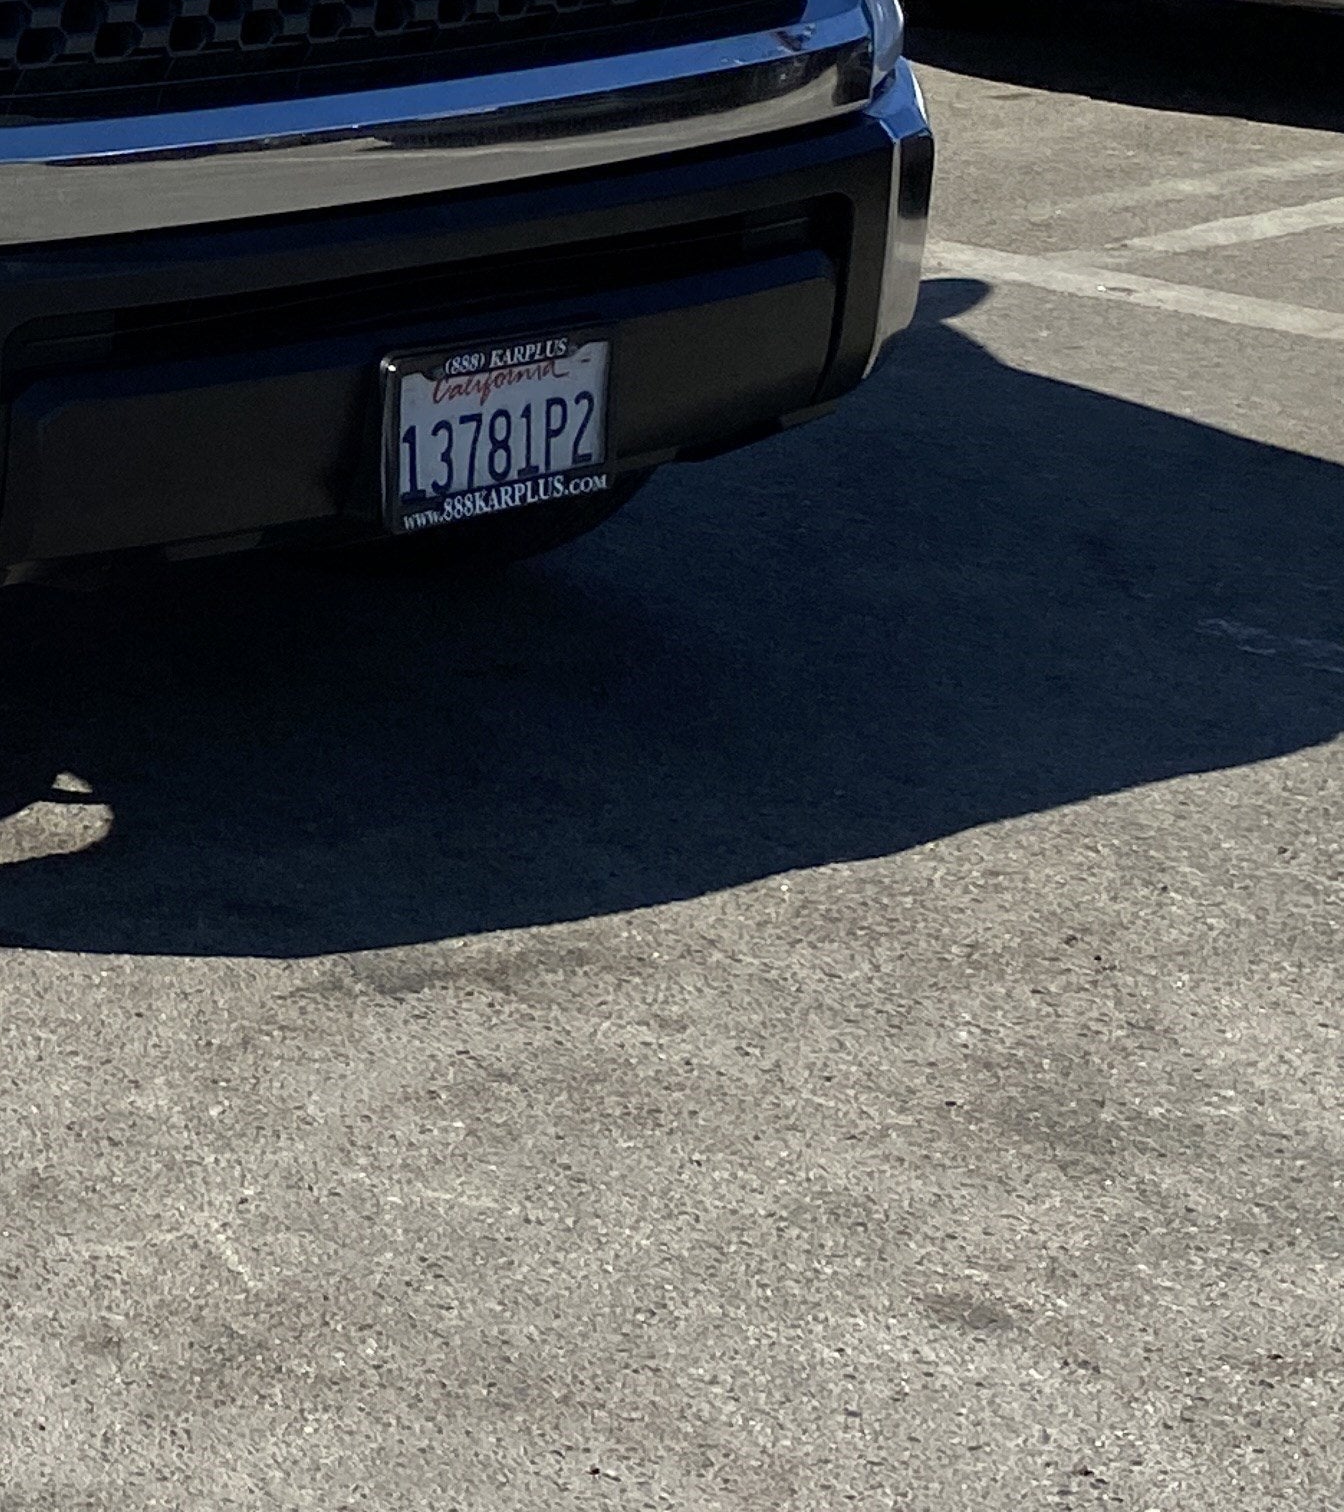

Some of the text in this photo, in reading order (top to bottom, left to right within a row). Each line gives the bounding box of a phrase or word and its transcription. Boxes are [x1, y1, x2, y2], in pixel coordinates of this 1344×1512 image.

[444, 337, 569, 375] (888) KARPLUS
[431, 360, 570, 405] California
[400, 390, 596, 503] 13781P2
